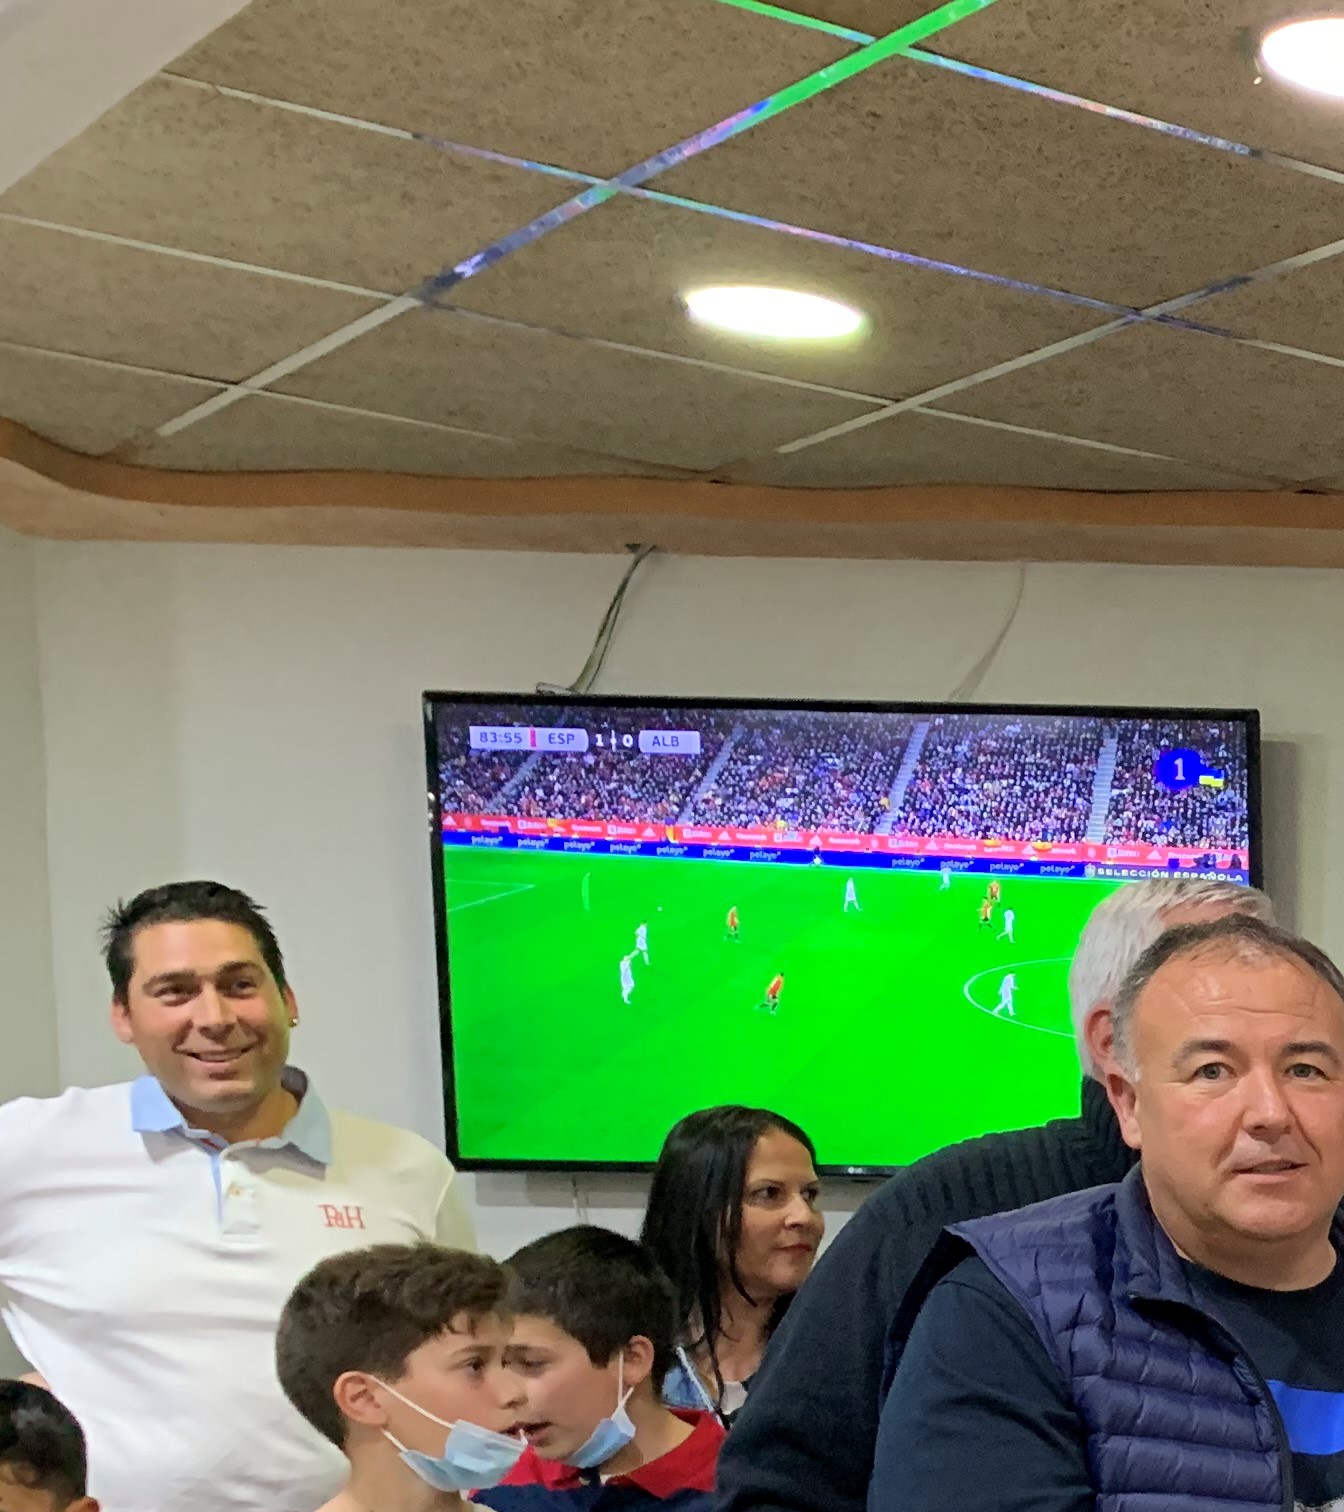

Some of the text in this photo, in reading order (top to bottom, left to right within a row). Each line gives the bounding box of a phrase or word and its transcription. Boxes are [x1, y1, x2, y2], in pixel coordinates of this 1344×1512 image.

[479, 732, 523, 744] 83:55
[548, 732, 576, 746] ESP
[595, 734, 634, 748] 1 0
[651, 736, 680, 748] ALB
[1173, 757, 1187, 781] 1
[1097, 867, 1169, 879] SELECCIÓN
